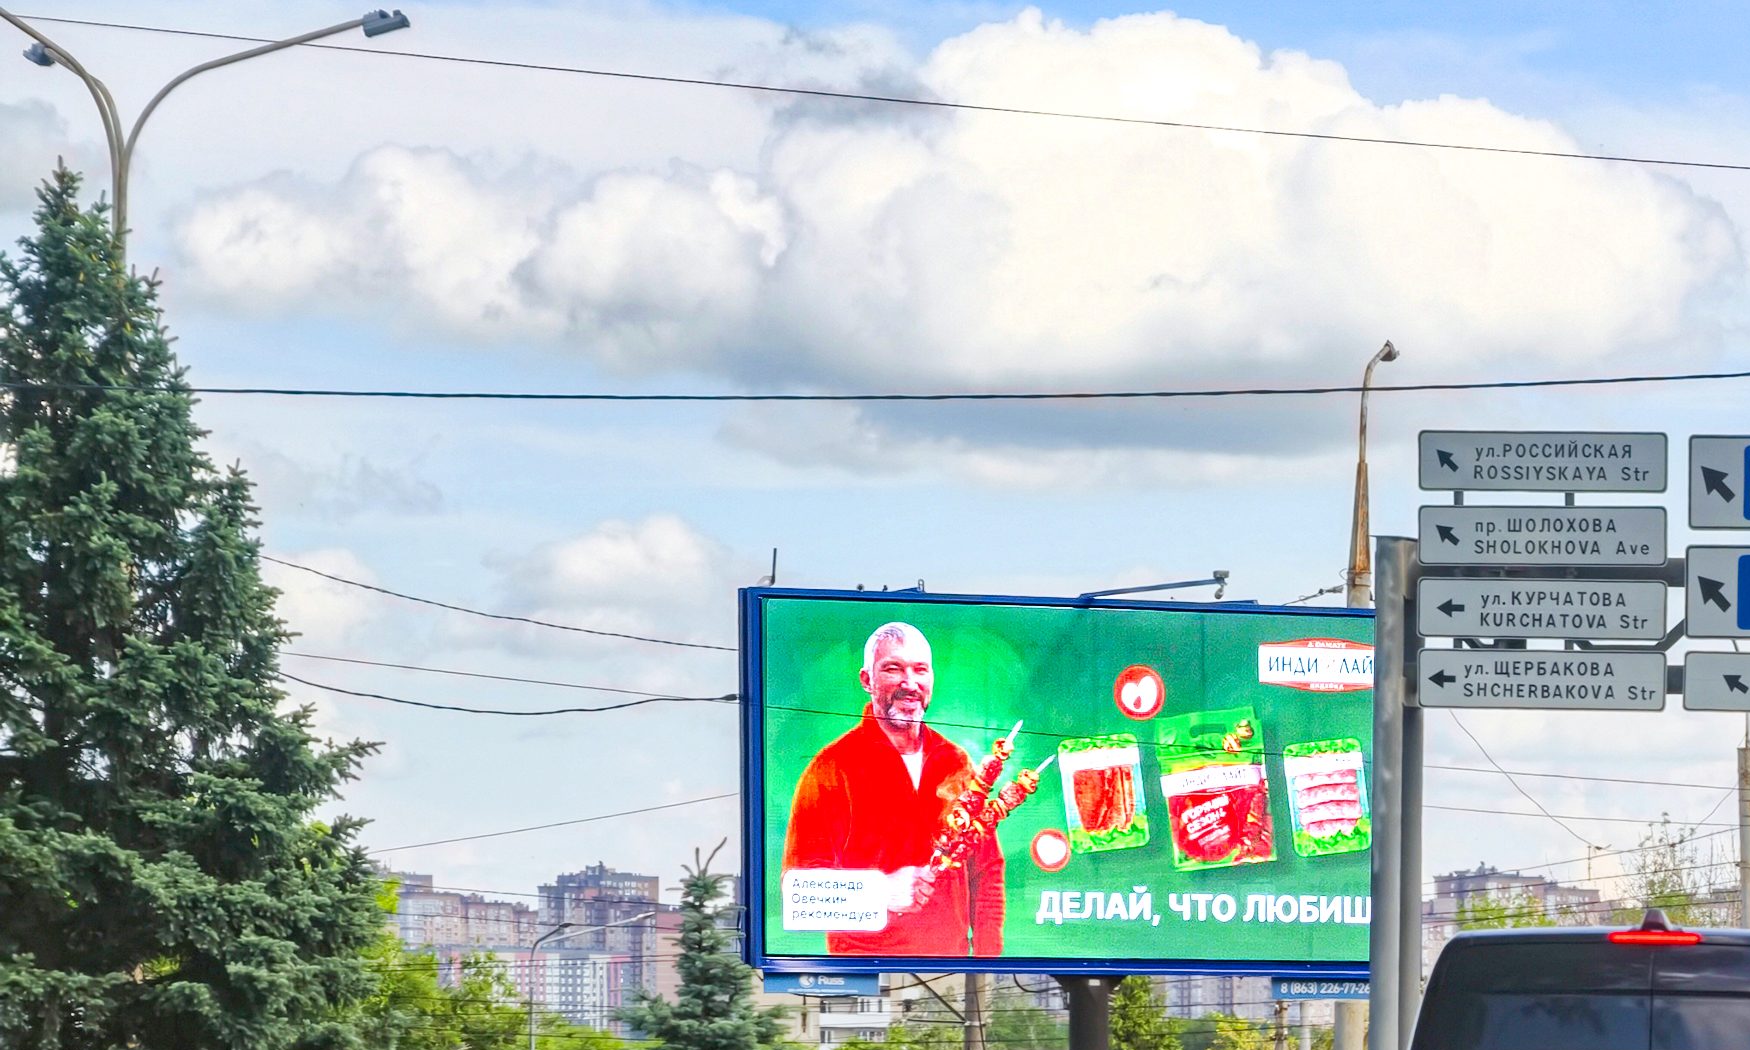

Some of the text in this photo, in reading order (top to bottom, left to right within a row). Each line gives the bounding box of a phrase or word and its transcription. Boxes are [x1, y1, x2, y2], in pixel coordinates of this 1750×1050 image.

[1473, 465, 1649, 481] ROSSIYSKAYA Str
[1474, 540, 1650, 555] SHOLOKHOVA Ave
[1479, 612, 1648, 629] KURCHATOVA Str
[1463, 683, 1656, 700] SHCHERBAKOVA Str
[792, 879, 863, 891] Александр
[1035, 886, 1161, 926] ДЕЛАЙ,
[1168, 894, 1238, 922] ЧТО
[1281, 983, 1288, 994] 8
[1290, 982, 1318, 995] (863)
